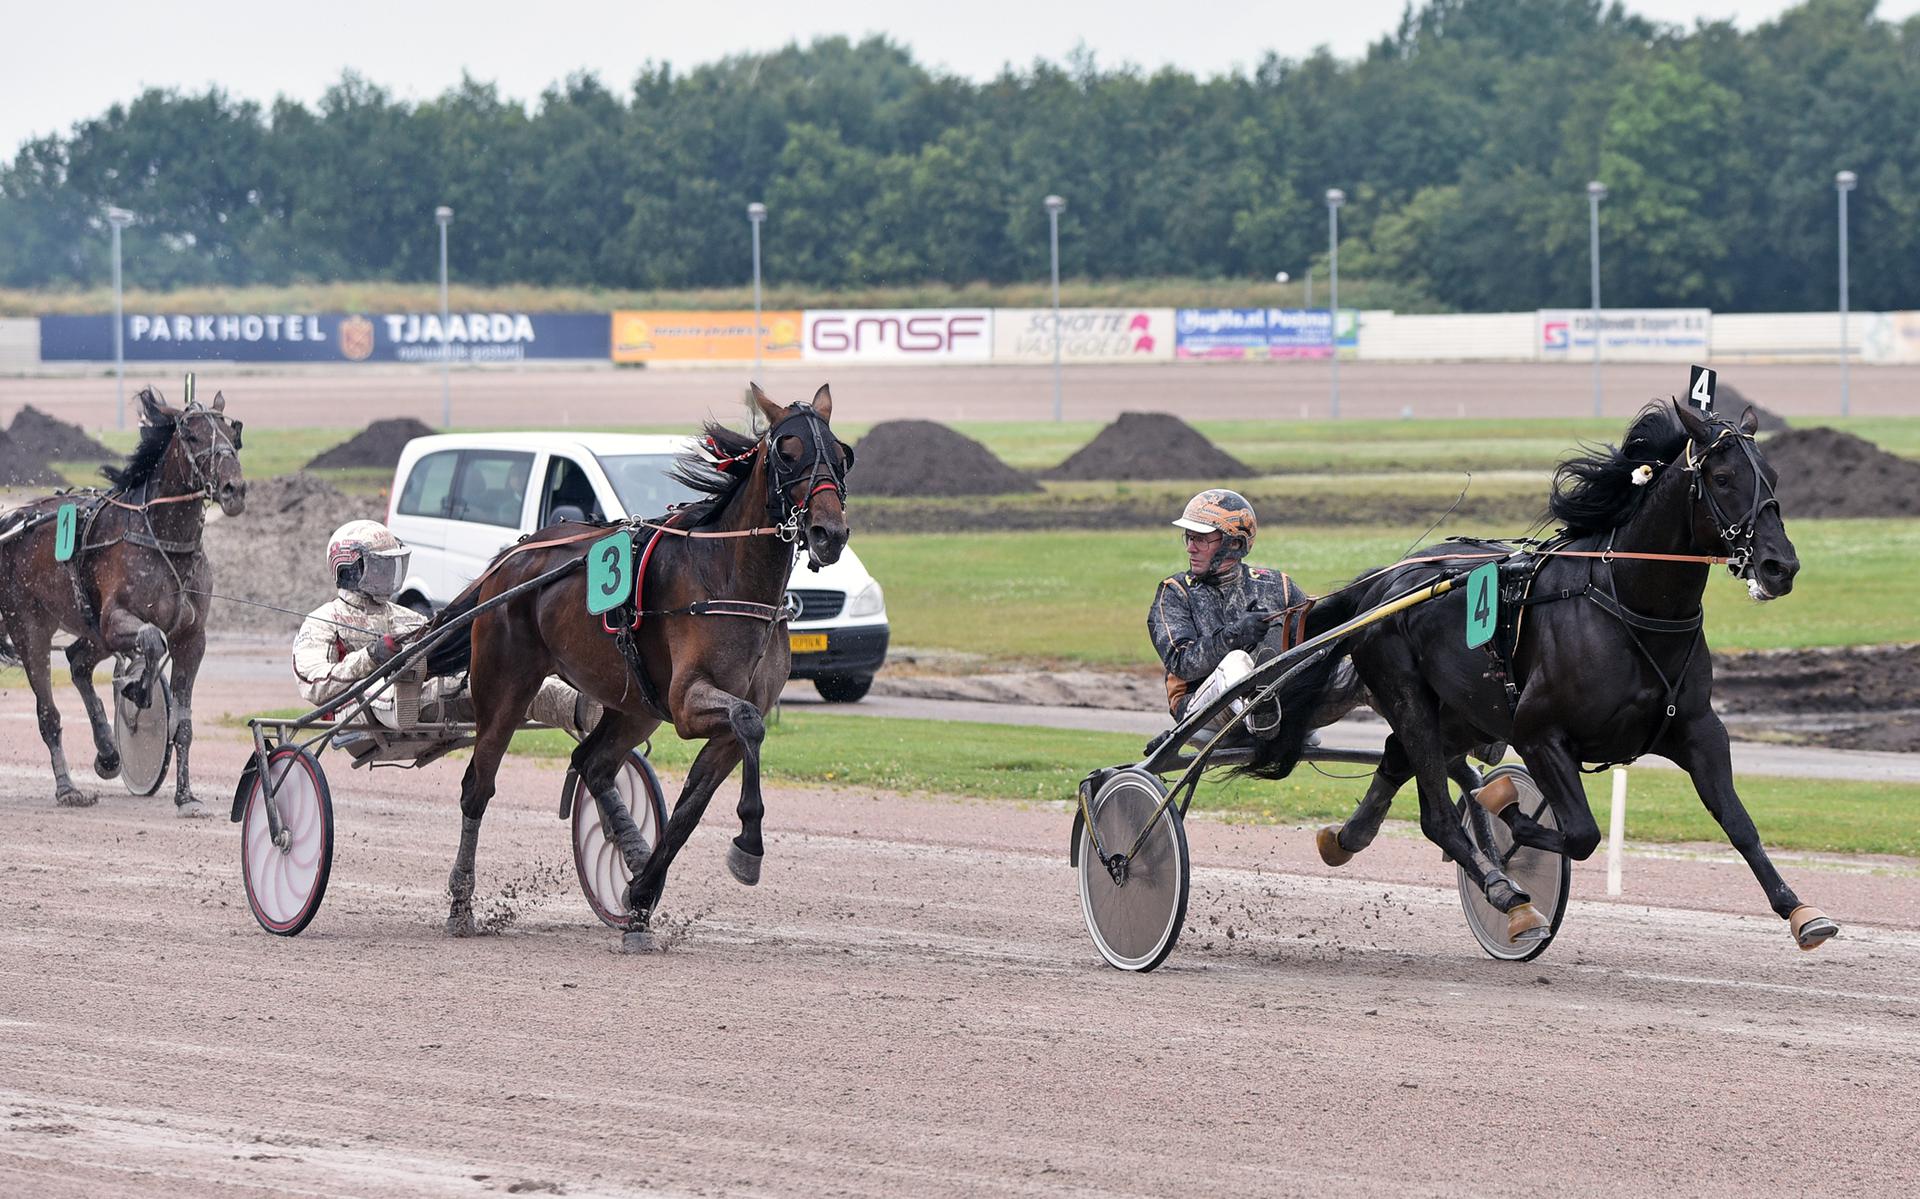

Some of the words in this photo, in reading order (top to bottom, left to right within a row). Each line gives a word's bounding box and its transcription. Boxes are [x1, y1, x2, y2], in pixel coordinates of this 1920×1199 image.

[130, 315, 326, 341] PARKHOTEL
[385, 313, 535, 342] TJAARDA
[813, 317, 984, 351] GMSF
[1691, 369, 1711, 411] 4
[62, 511, 70, 550] 1
[601, 546, 621, 595] 3
[1474, 575, 1490, 628] 4
